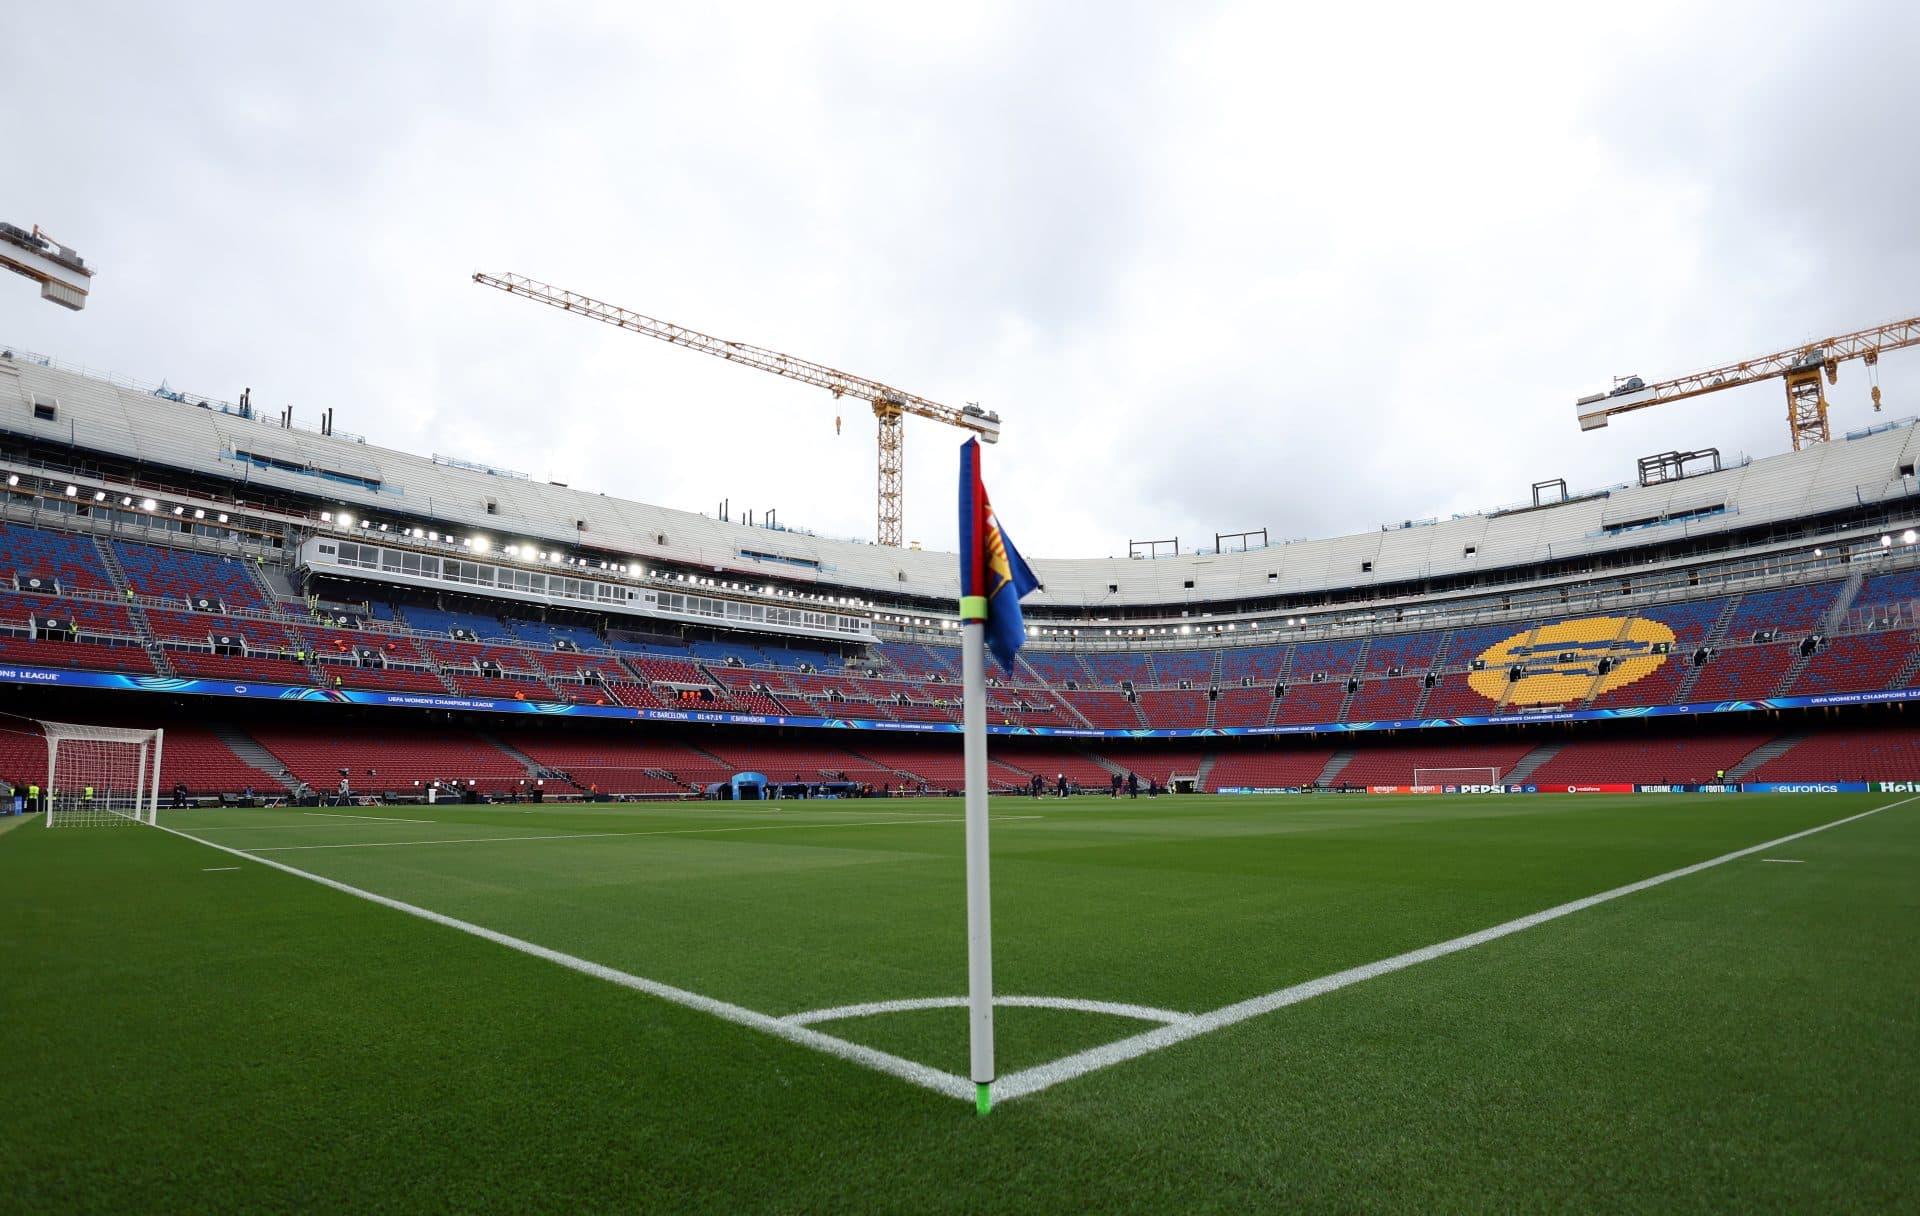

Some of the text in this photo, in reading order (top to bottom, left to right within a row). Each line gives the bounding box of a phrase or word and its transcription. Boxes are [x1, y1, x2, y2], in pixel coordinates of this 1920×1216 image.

[1863, 692, 1906, 700] CHAMPIONS
[435, 699, 471, 707] CHAMPIONS
[650, 710, 656, 718] FC
[657, 710, 688, 719] BARCELONA
[1373, 786, 1397, 794] amazon
[1410, 785, 1436, 794] amazon
[1461, 785, 1505, 793] PEPSI
[1641, 785, 1685, 793] WELCOME ALL
[1779, 784, 1838, 793] euronics
